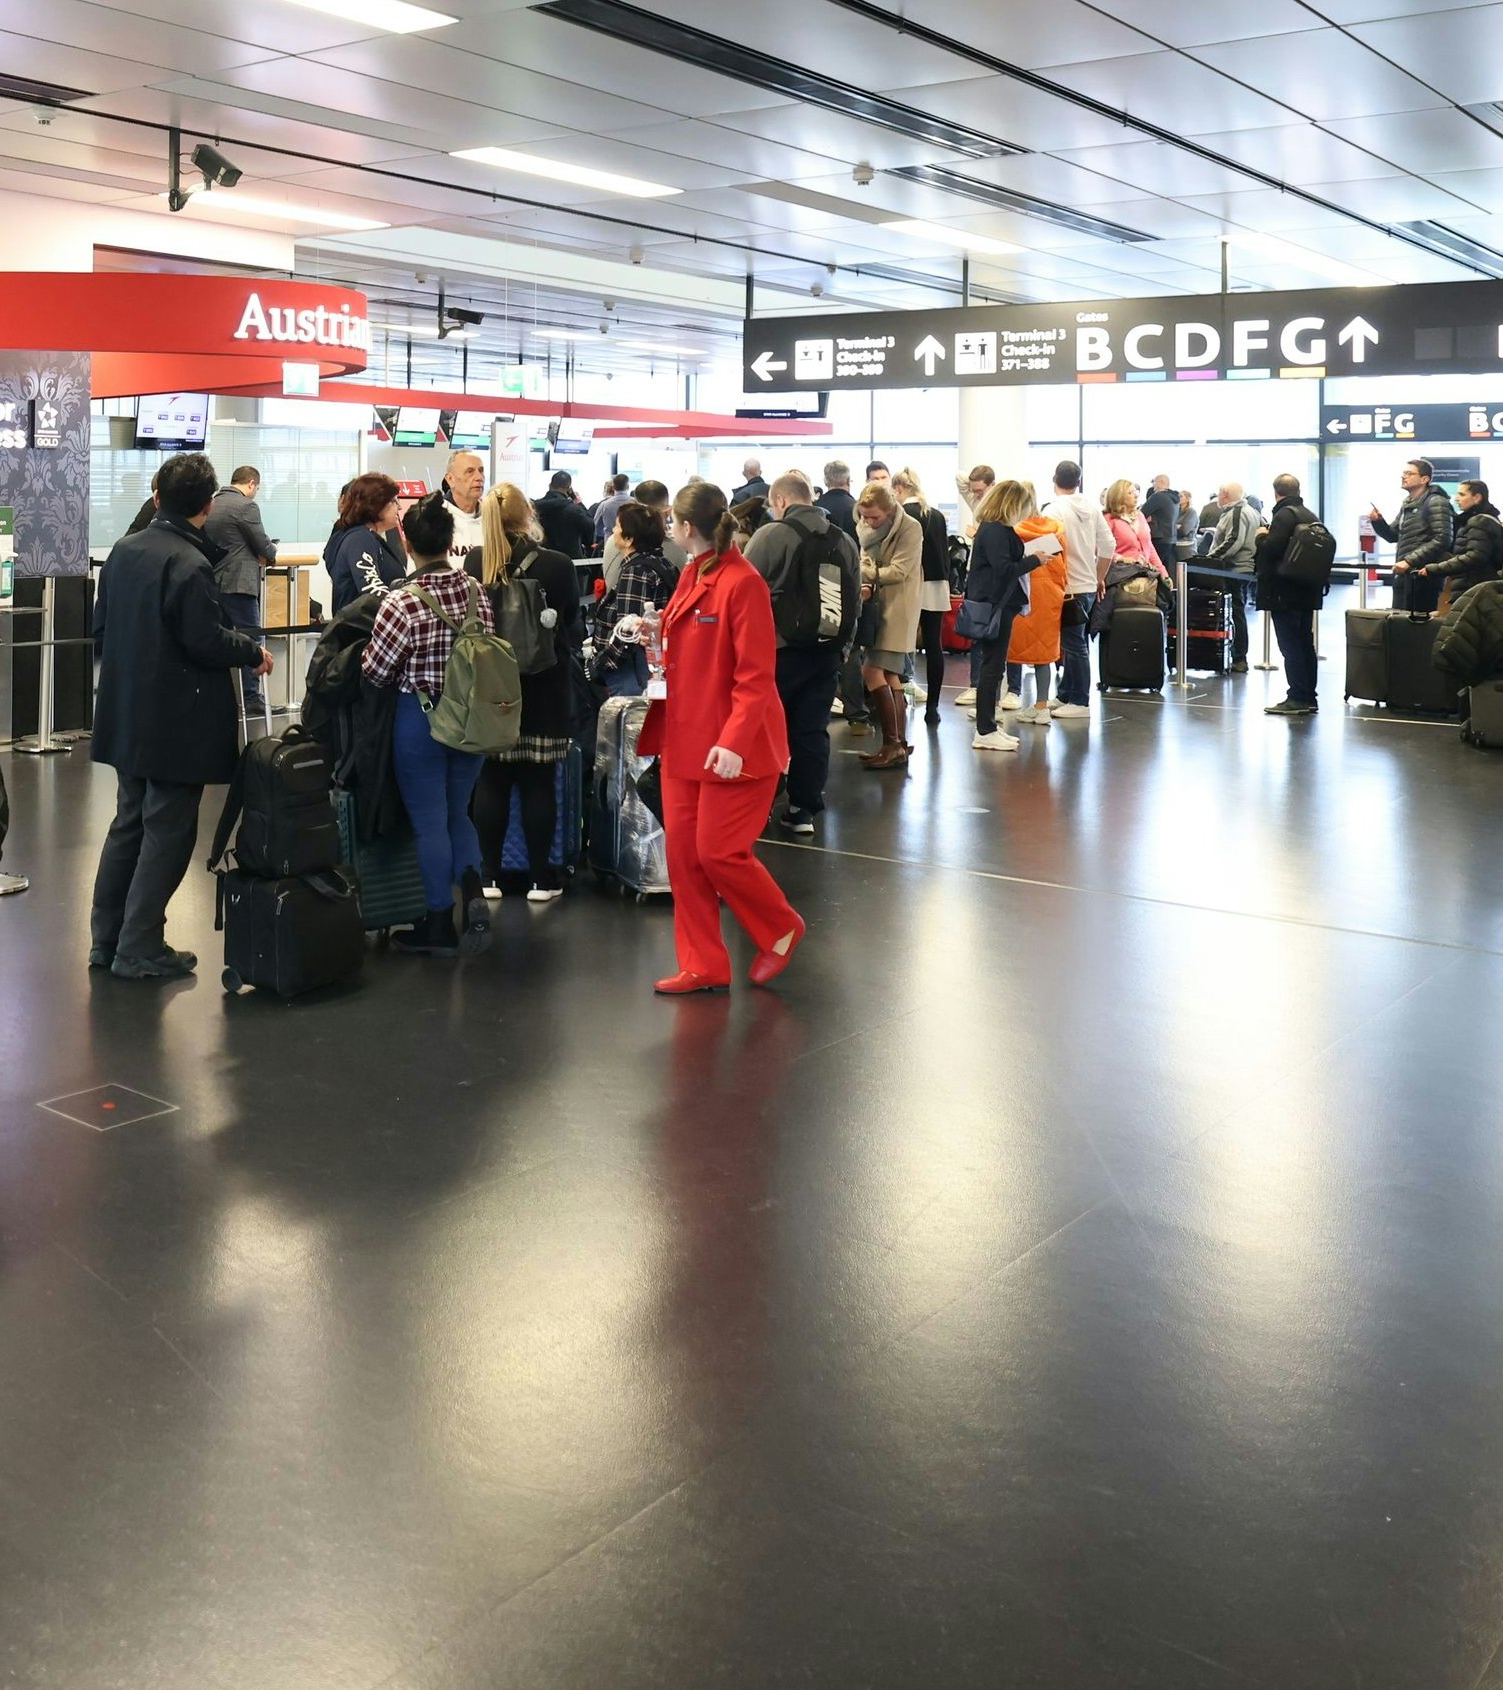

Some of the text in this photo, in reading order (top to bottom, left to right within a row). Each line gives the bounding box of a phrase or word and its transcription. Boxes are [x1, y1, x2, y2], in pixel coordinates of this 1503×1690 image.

[233, 292, 372, 350] Austrian
[1001, 328, 1067, 343] Terminal 3
[1001, 342, 1056, 357] Check-in
[37, 437, 59, 447] GOLD
[818, 575, 842, 627] NIKE
